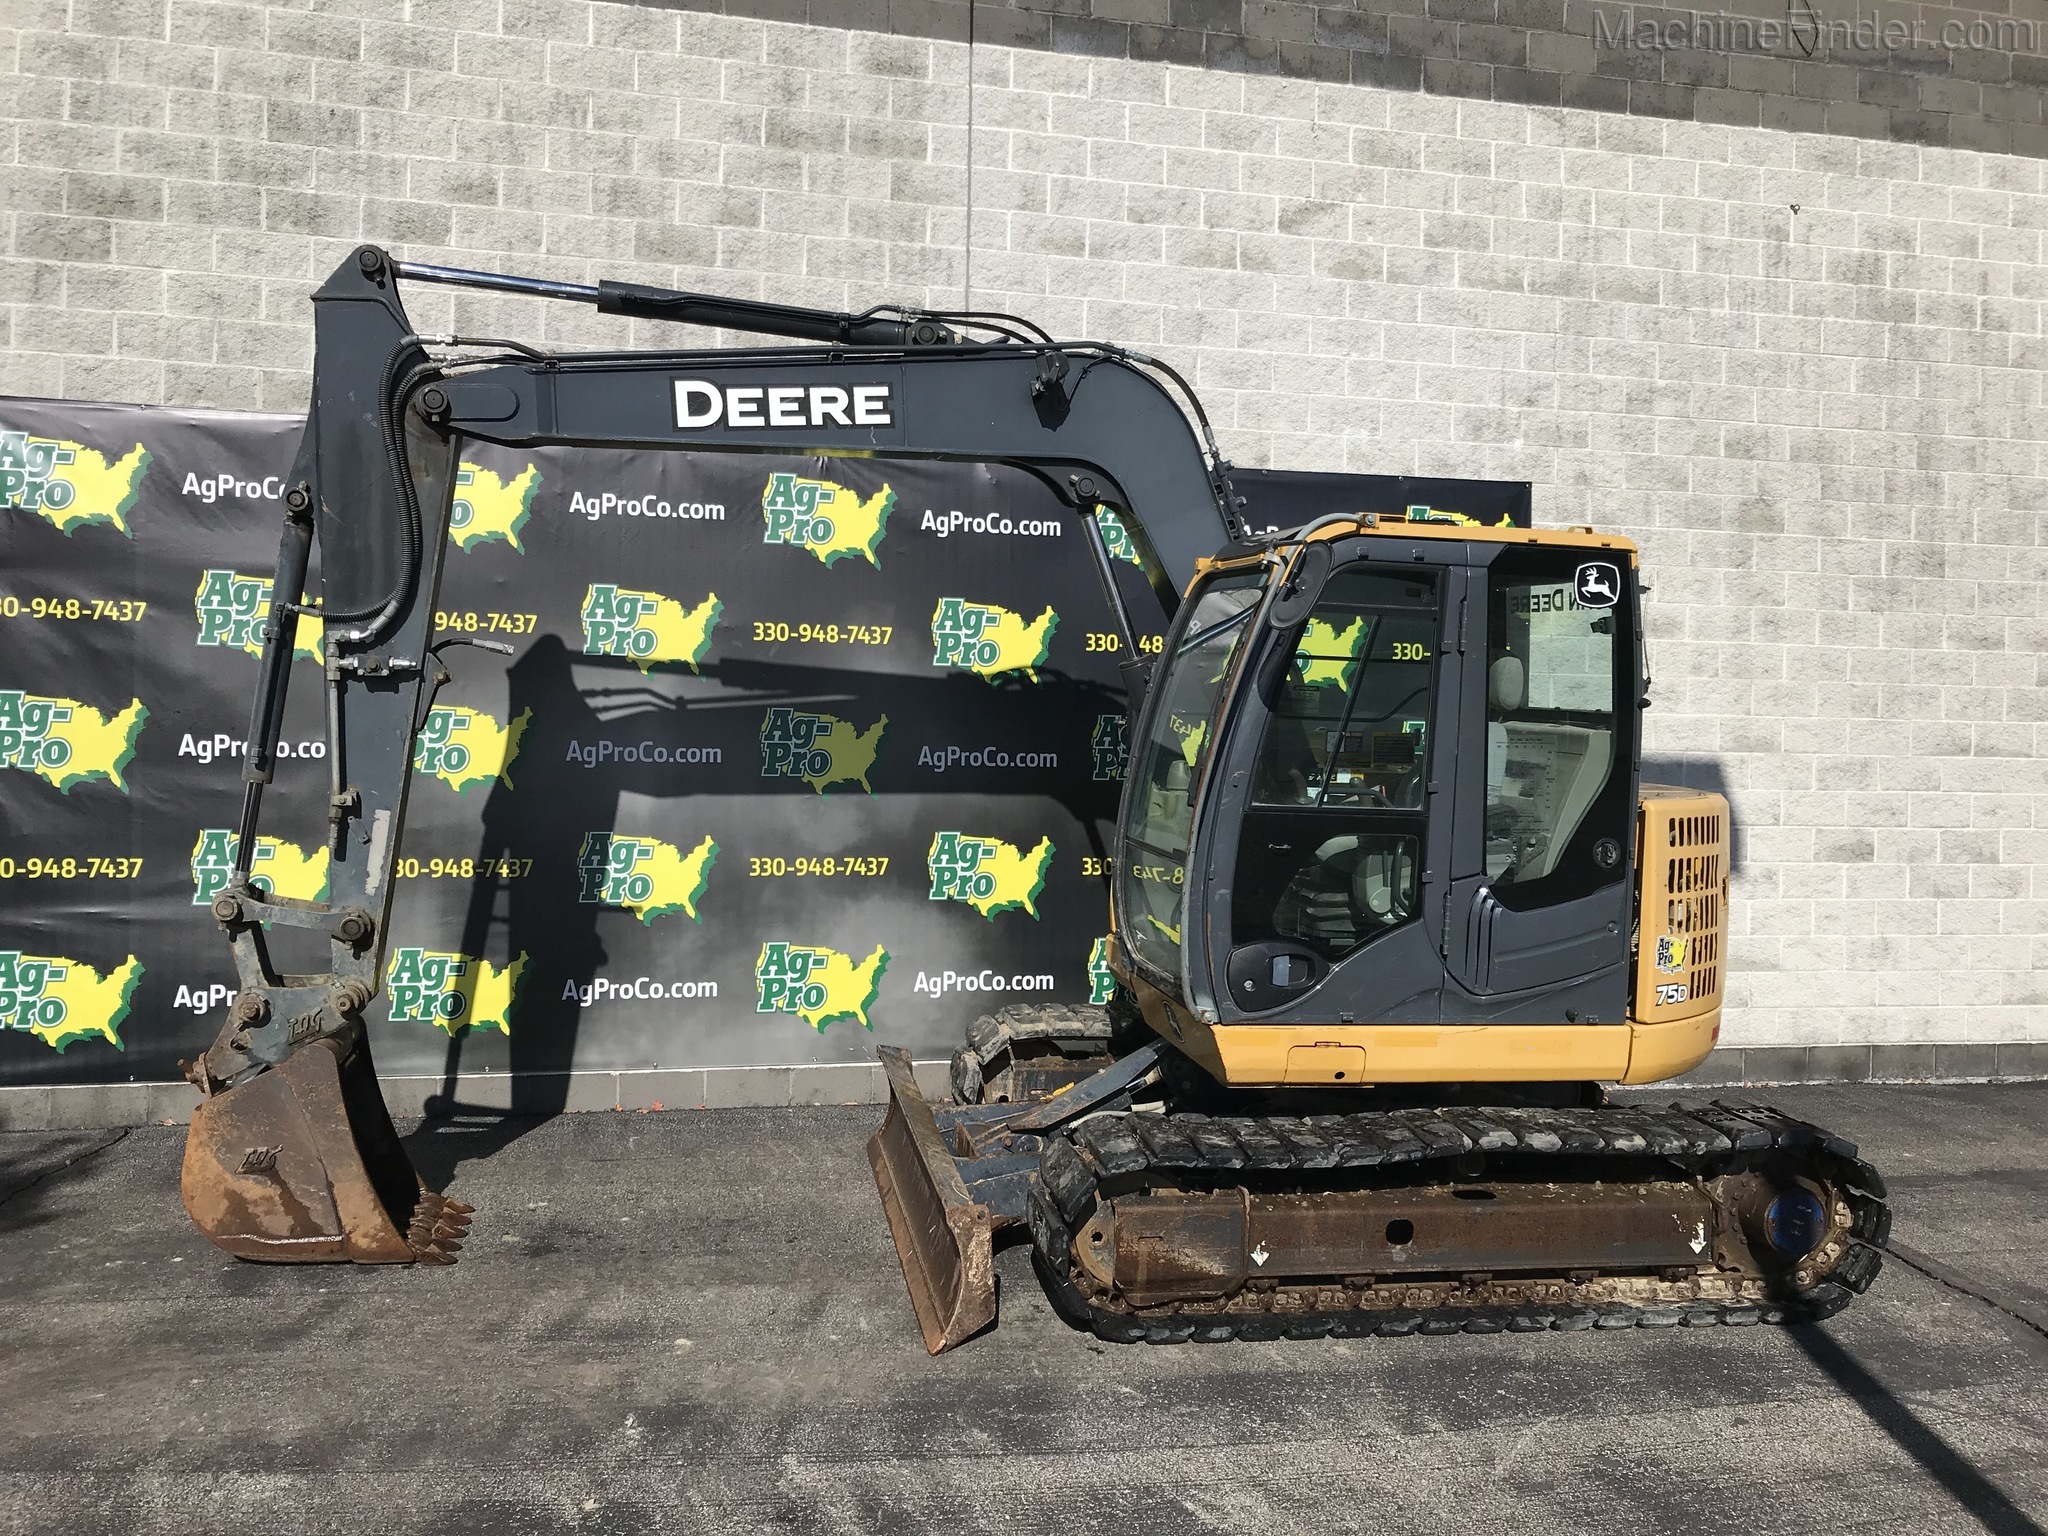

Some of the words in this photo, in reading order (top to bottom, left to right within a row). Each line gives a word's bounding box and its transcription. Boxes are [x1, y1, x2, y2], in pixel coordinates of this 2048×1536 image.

[673, 379, 892, 428] DEERE
[569, 491, 726, 521] AgProCo.com
[764, 473, 834, 516] Ag-
[763, 508, 834, 544] Pro
[920, 510, 1062, 537] AgProCo.com
[0, 596, 147, 621] 0-948-7437
[584, 583, 658, 623] Ag-
[934, 597, 1001, 635] Ag-
[583, 619, 658, 656] Pro
[752, 622, 893, 645] 330-948-7437
[932, 632, 1000, 667] Pro
[762, 708, 832, 750] Ag-
[565, 740, 722, 768] AgProCo.com
[761, 742, 832, 777] Pro
[917, 746, 1058, 772] AgProCo.com
[580, 832, 654, 873] Ag-
[749, 857, 889, 878] 330-948-7437
[930, 832, 997, 871] Ag-
[579, 867, 654, 903] Pro
[929, 866, 996, 900] Pro
[390, 947, 466, 990] Ag-
[758, 942, 827, 982] Ag-
[388, 982, 466, 1021] Pro
[561, 978, 718, 1007] AgProCo.com
[756, 976, 827, 1013] Pro
[913, 970, 1055, 998] AgProCo.com
[1655, 983, 1688, 1007] 75D
